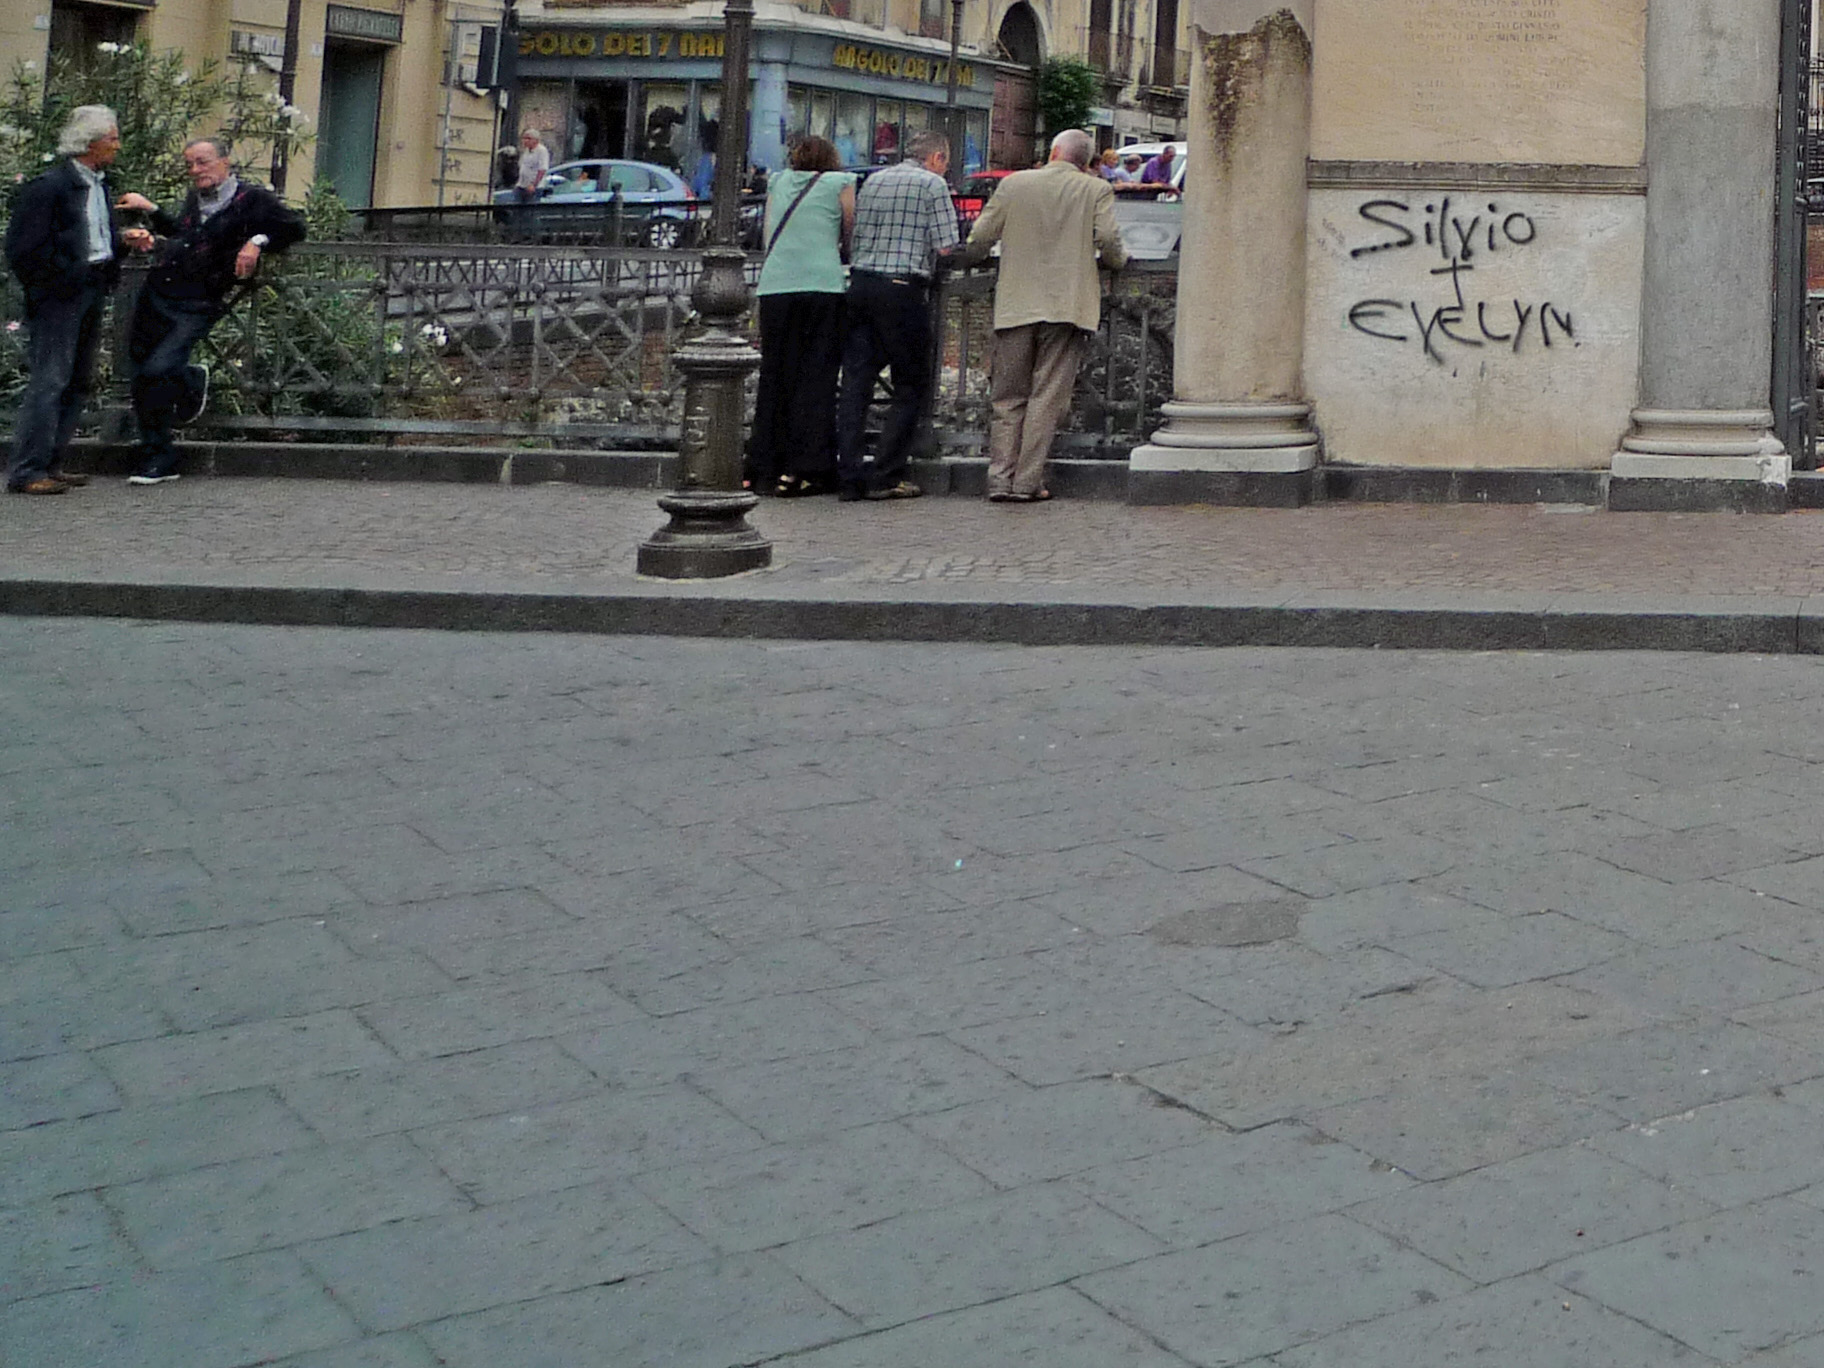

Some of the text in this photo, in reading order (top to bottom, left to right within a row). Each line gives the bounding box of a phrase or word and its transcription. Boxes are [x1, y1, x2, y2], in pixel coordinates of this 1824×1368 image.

[602, 32, 651, 57] DEI
[656, 33, 674, 58] 7
[1350, 196, 1536, 261] Silvio
